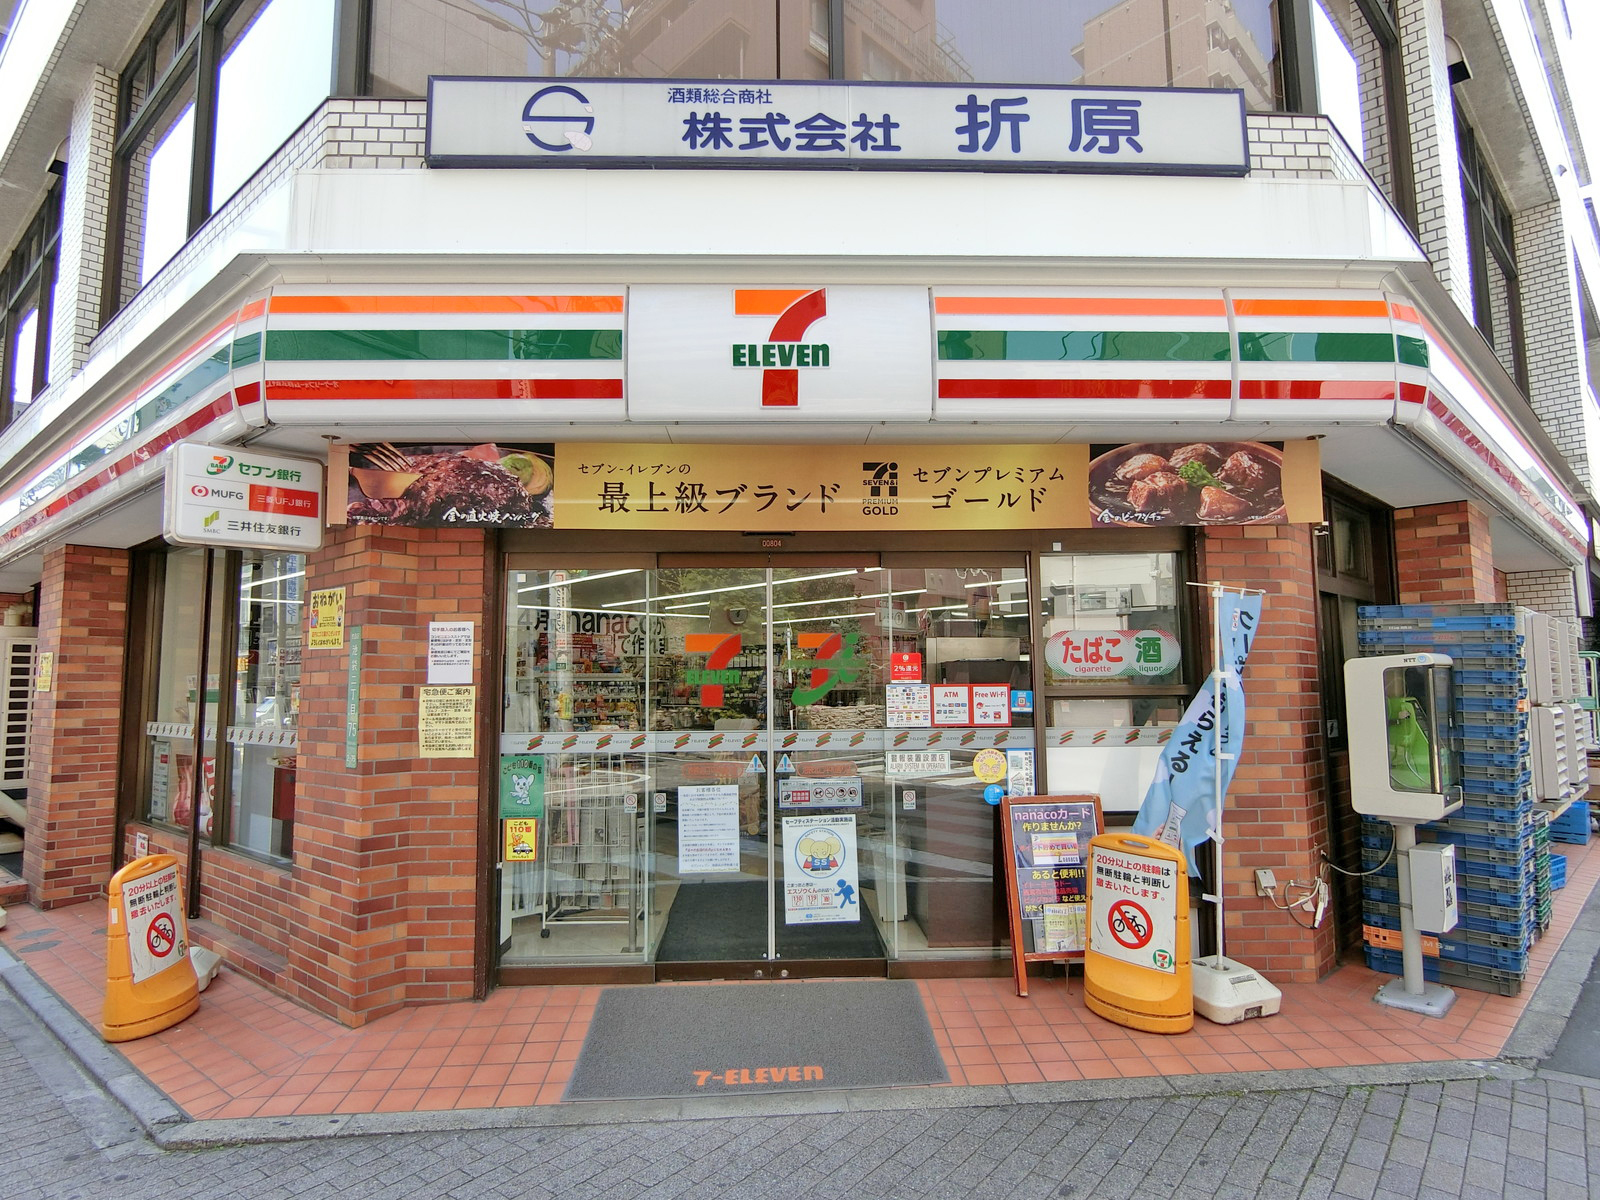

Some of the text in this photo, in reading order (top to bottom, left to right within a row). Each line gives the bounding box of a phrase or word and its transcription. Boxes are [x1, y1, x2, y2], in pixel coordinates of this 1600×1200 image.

[667, 87, 773, 104] 酒類総合商社
[682, 94, 1144, 154] 株式会社 折原
[238, 462, 302, 482] セブン銀行
[912, 466, 1065, 483] セブンプレミアム
[211, 489, 244, 500] MUFG
[257, 494, 312, 508] 三菱UFJ銀行
[597, 481, 841, 515] 最上級ブランド
[931, 487, 1048, 513] ゴールド
[443, 507, 543, 524] 金の直火焼ハンバーグ
[862, 506, 899, 515] GOLD
[1097, 509, 1166, 523] 金のビーフシチュー
[227, 520, 302, 537] 三井住友銀行
[762, 539, 782, 548] 00804
[312, 592, 343, 609] おねがい
[1062, 636, 1161, 664] たばこ 酒
[1075, 665, 1163, 673] cigarette liquor
[348, 722, 357, 737] 75
[891, 753, 946, 762] 警報装置設置店
[1014, 807, 1091, 820] nanacoカード
[1022, 821, 1082, 832] 作りませんか?
[1032, 868, 1085, 879] あると便利!!
[1096, 854, 1171, 876] 20分以上の駐輪は
[1096, 865, 1171, 889] 無断駐輪と判断し
[1096, 877, 1165, 901] 撤去いたします。
